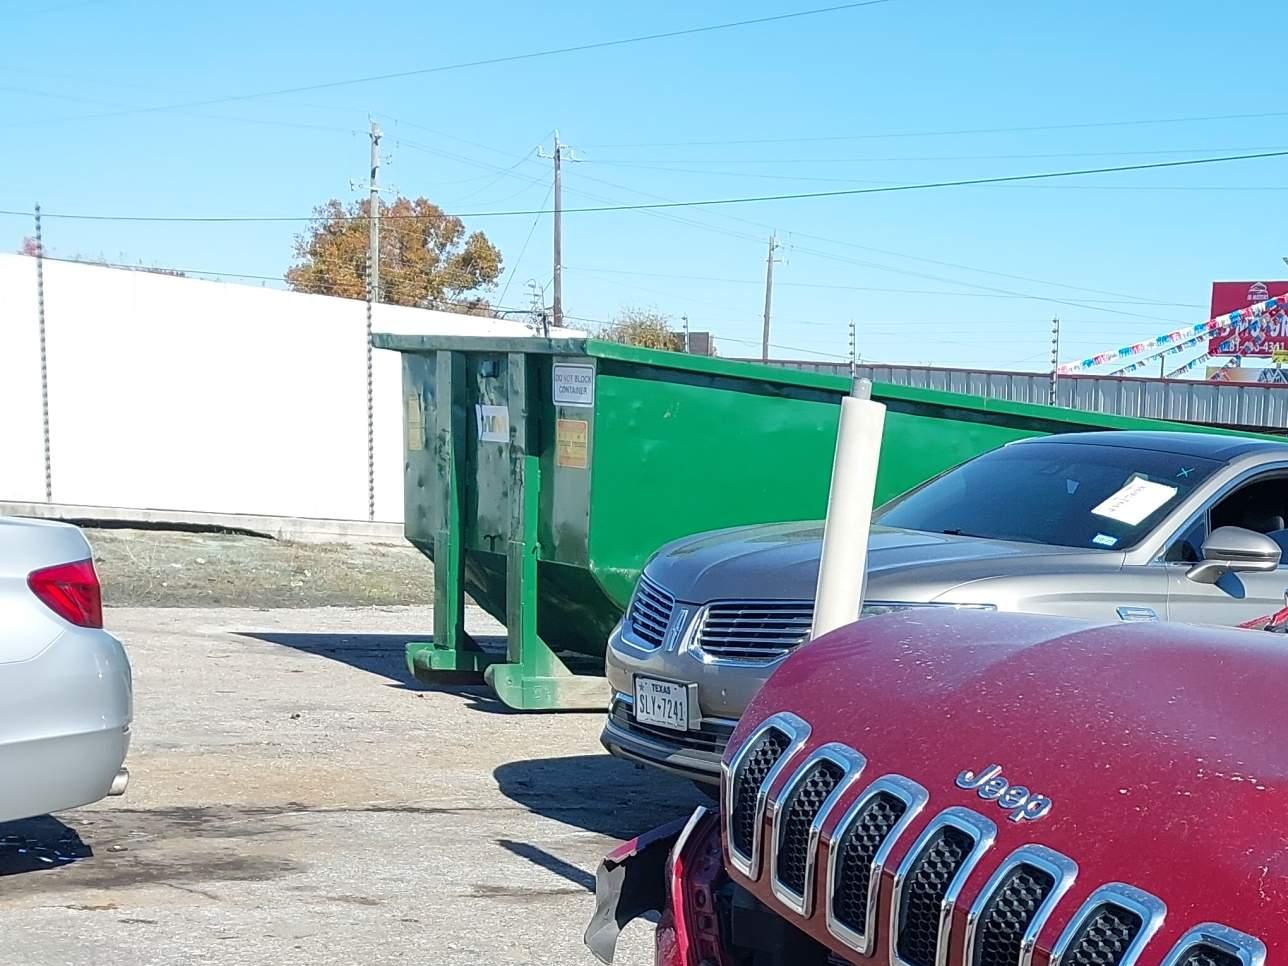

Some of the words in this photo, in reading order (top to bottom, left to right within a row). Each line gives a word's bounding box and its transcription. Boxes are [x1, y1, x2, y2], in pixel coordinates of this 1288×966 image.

[574, 375, 592, 384] BLOCK
[651, 683, 671, 695] TEXAS
[956, 763, 1052, 822] Jeep
